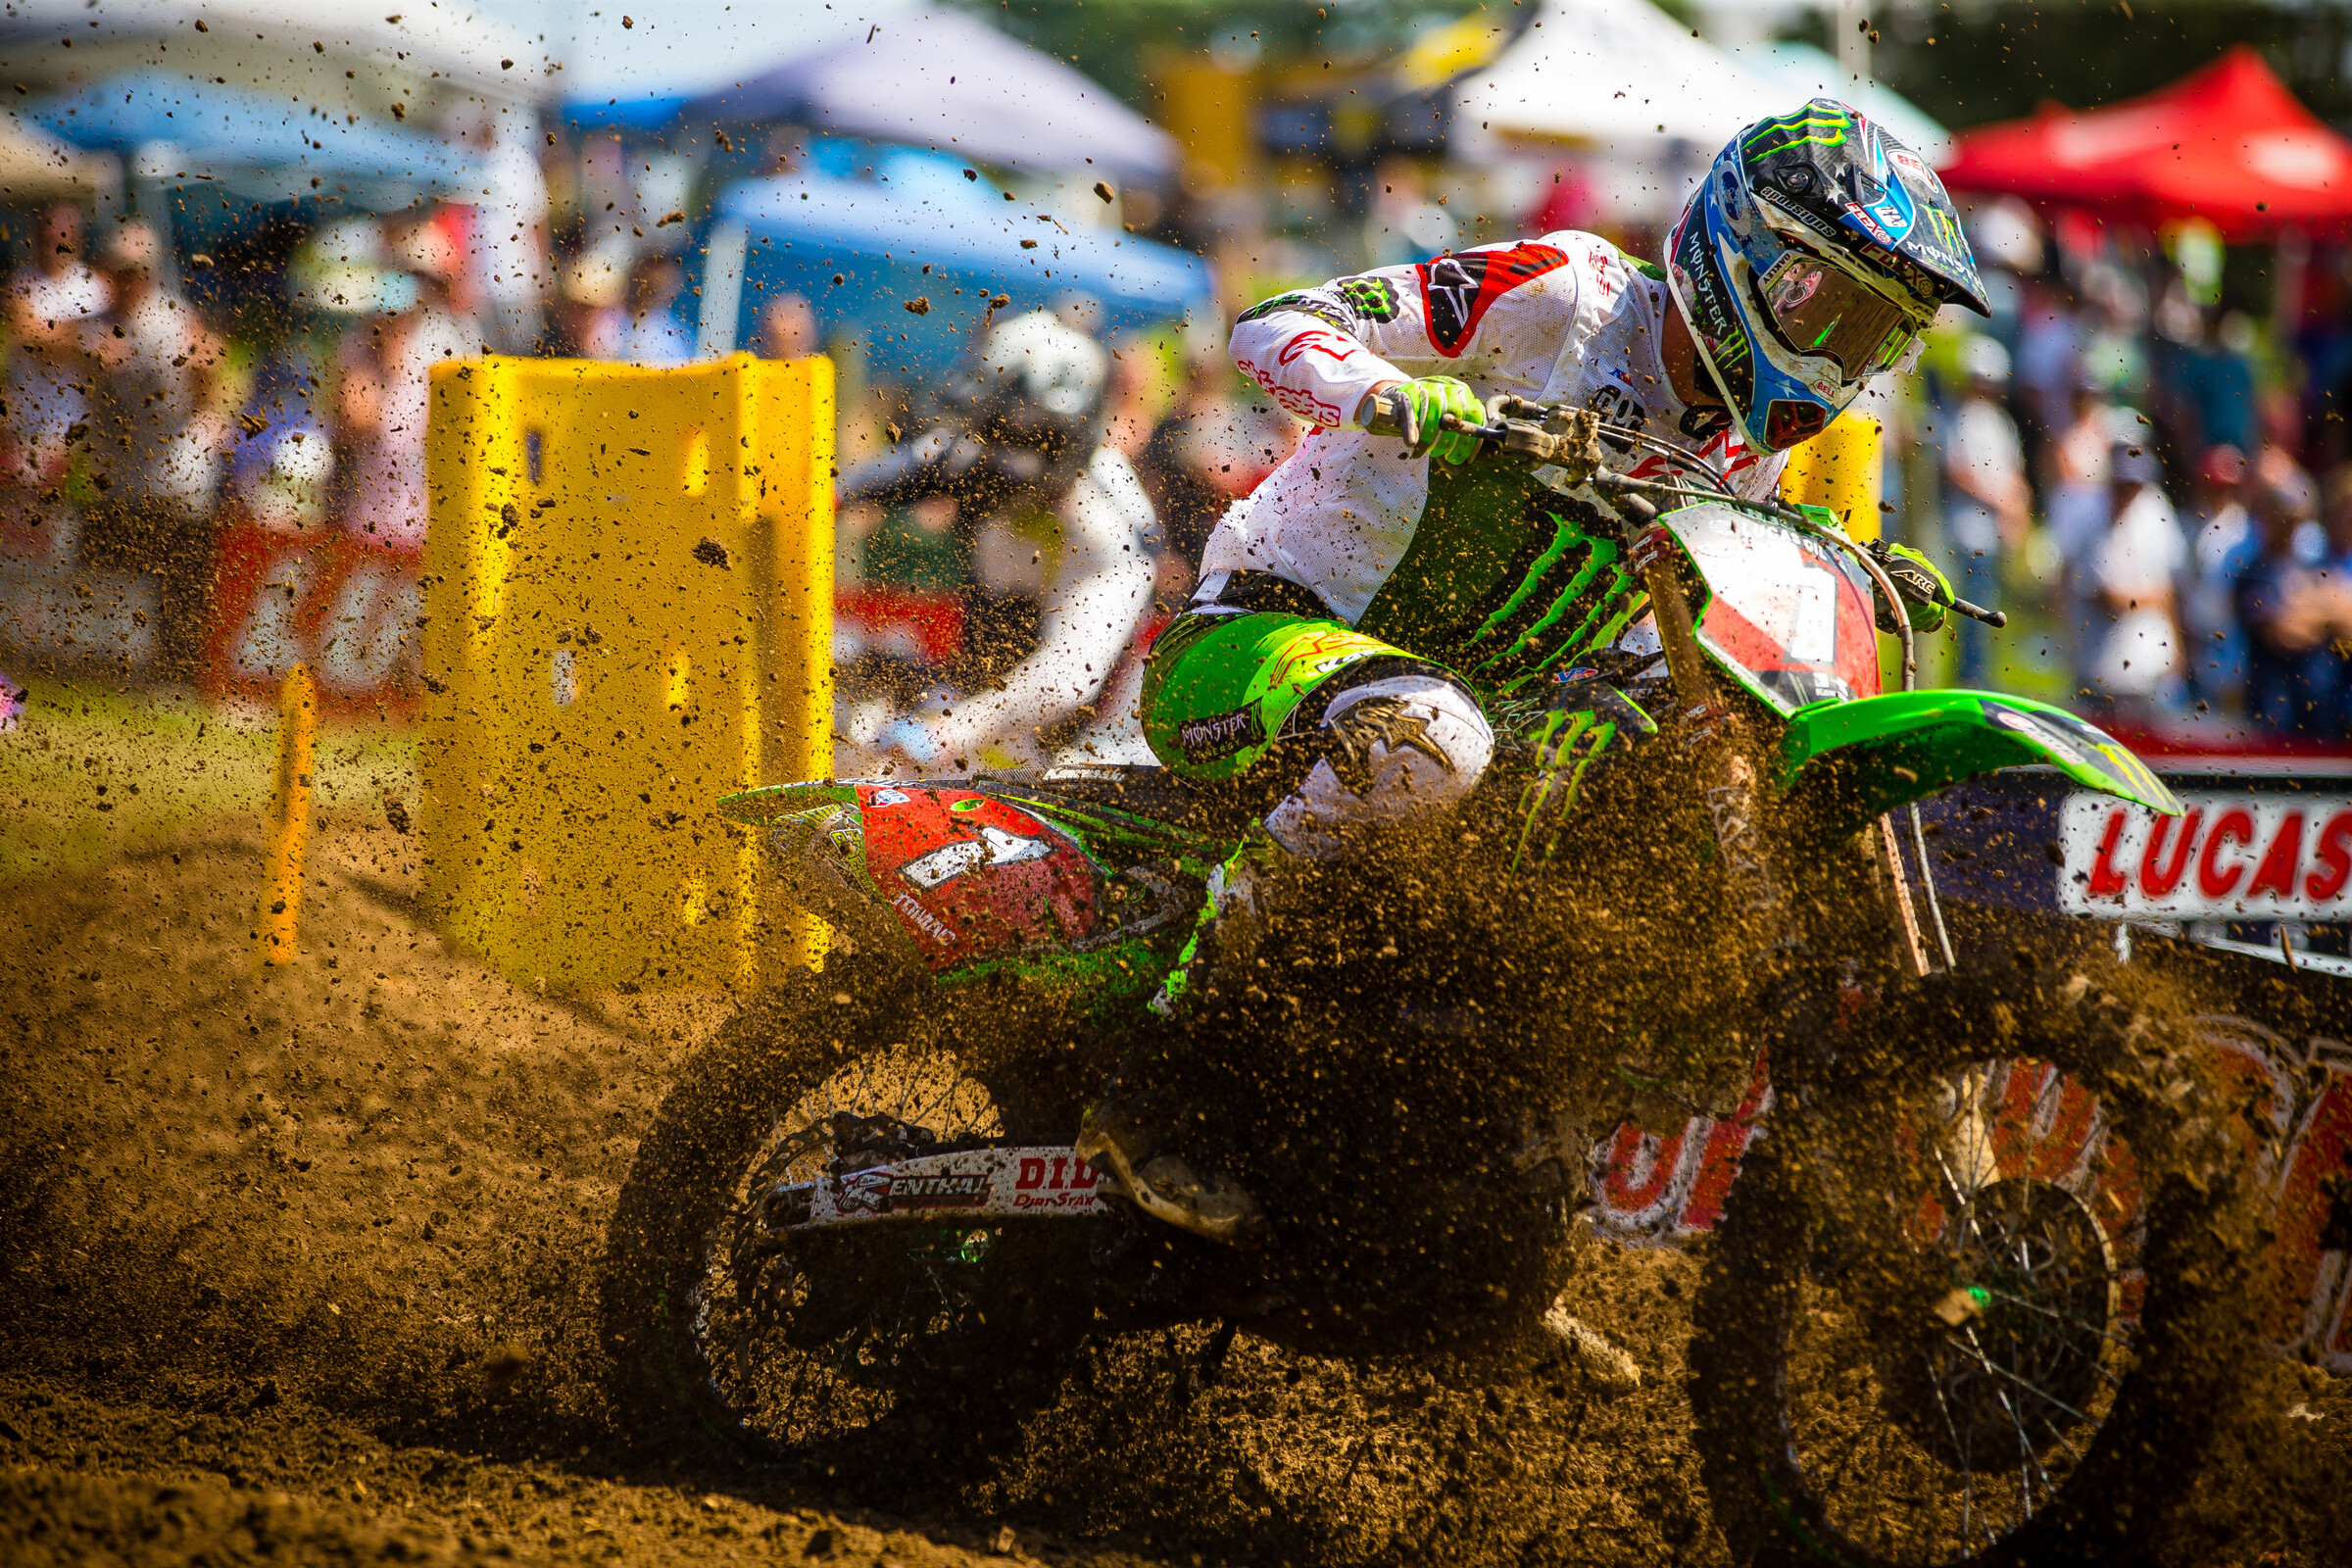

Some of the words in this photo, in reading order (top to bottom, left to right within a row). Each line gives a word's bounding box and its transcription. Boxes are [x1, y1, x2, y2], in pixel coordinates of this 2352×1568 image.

[1846, 202, 1883, 234] FLEX
[1689, 231, 1728, 336] MONSTER
[1765, 254, 1790, 285] OAKLEY
[1862, 242, 1923, 287] FLEX
[1906, 241, 1986, 287] MONST
[1237, 359, 1342, 428] ainestars
[1817, 381, 1836, 398] BELL
[1740, 521, 1802, 546] LUCAS
[1804, 542, 1828, 561] OIL
[2085, 804, 2352, 901] LUCAS
[892, 891, 957, 948] TOMAC
